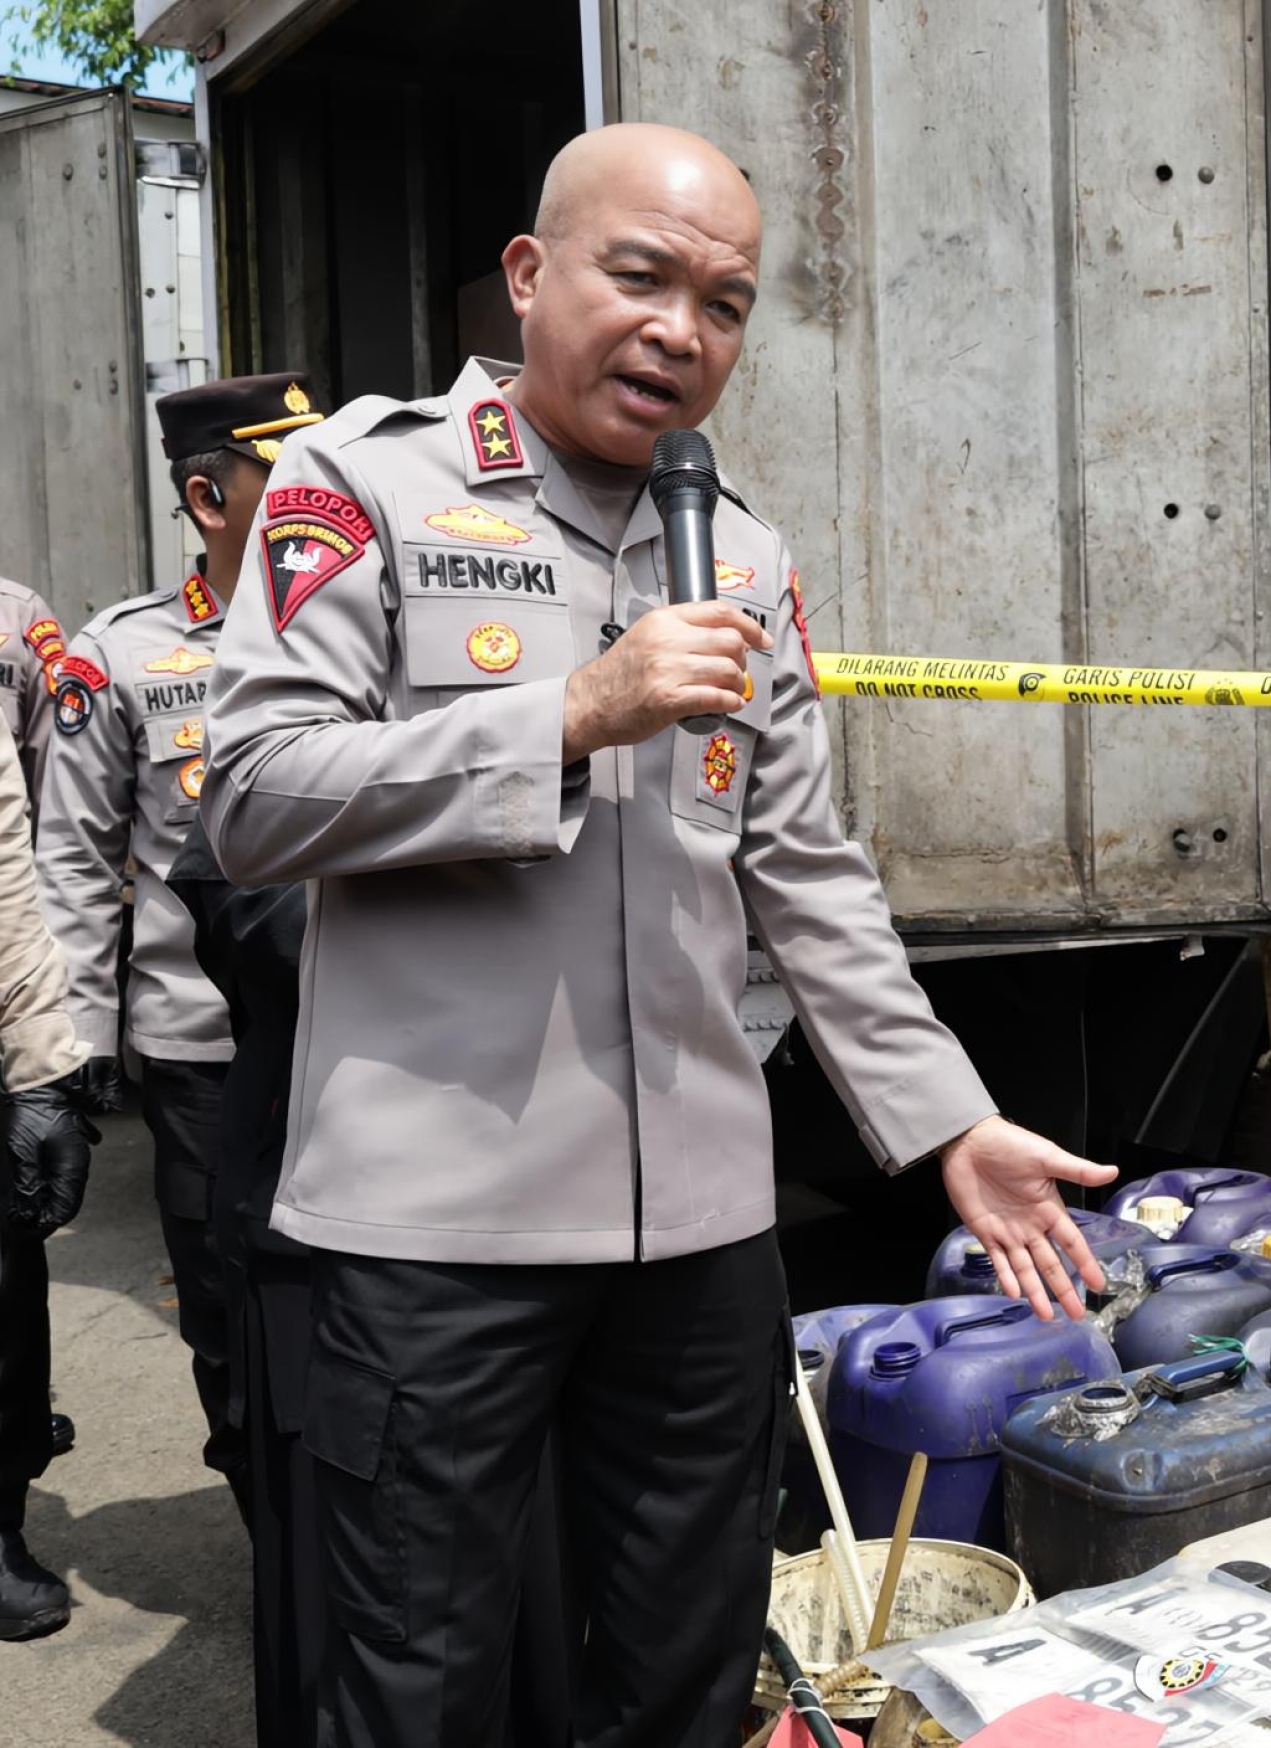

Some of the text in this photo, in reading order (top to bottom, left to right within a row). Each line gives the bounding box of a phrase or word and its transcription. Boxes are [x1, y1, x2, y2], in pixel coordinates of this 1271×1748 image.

[266, 523, 355, 556] KORPS BRIMOB
[418, 553, 556, 595] HENGKI
[836, 657, 919, 678] DILARANG
[923, 661, 1009, 682] MELINTAS
[1063, 668, 1123, 688] GARIS
[1127, 671, 1196, 691] POLISI
[967, 1638, 1047, 1666] A
